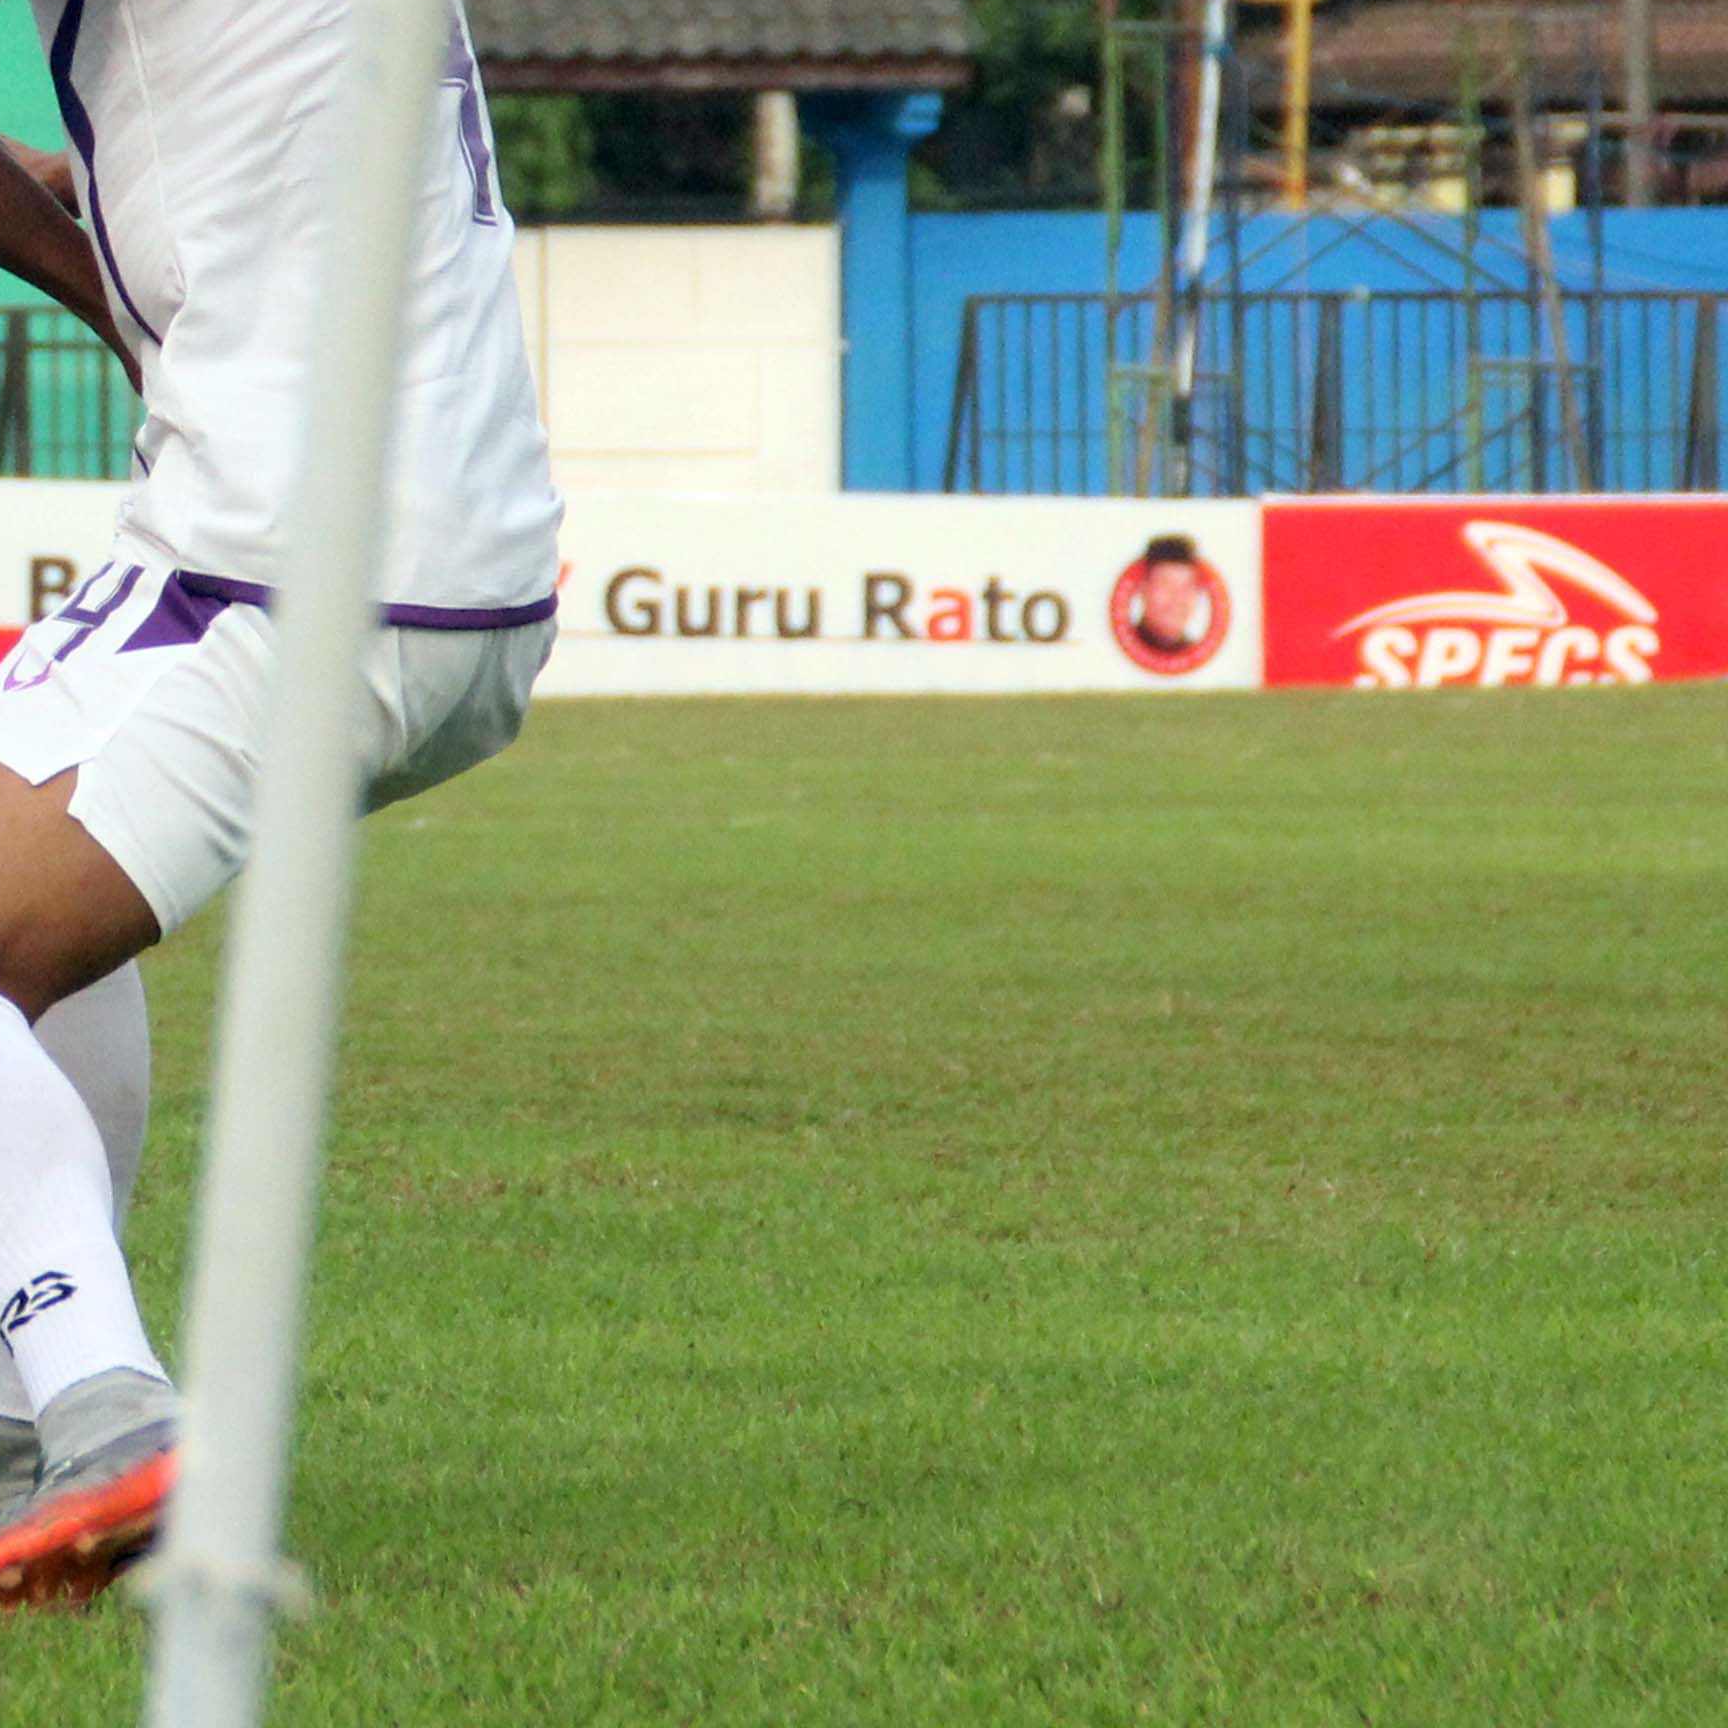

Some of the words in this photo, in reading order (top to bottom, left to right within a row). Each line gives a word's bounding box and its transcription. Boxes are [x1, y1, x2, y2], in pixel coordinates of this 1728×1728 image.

[603, 567, 822, 639] Guru
[862, 572, 1071, 644] Rato
[1352, 625, 1661, 686] SPECS
